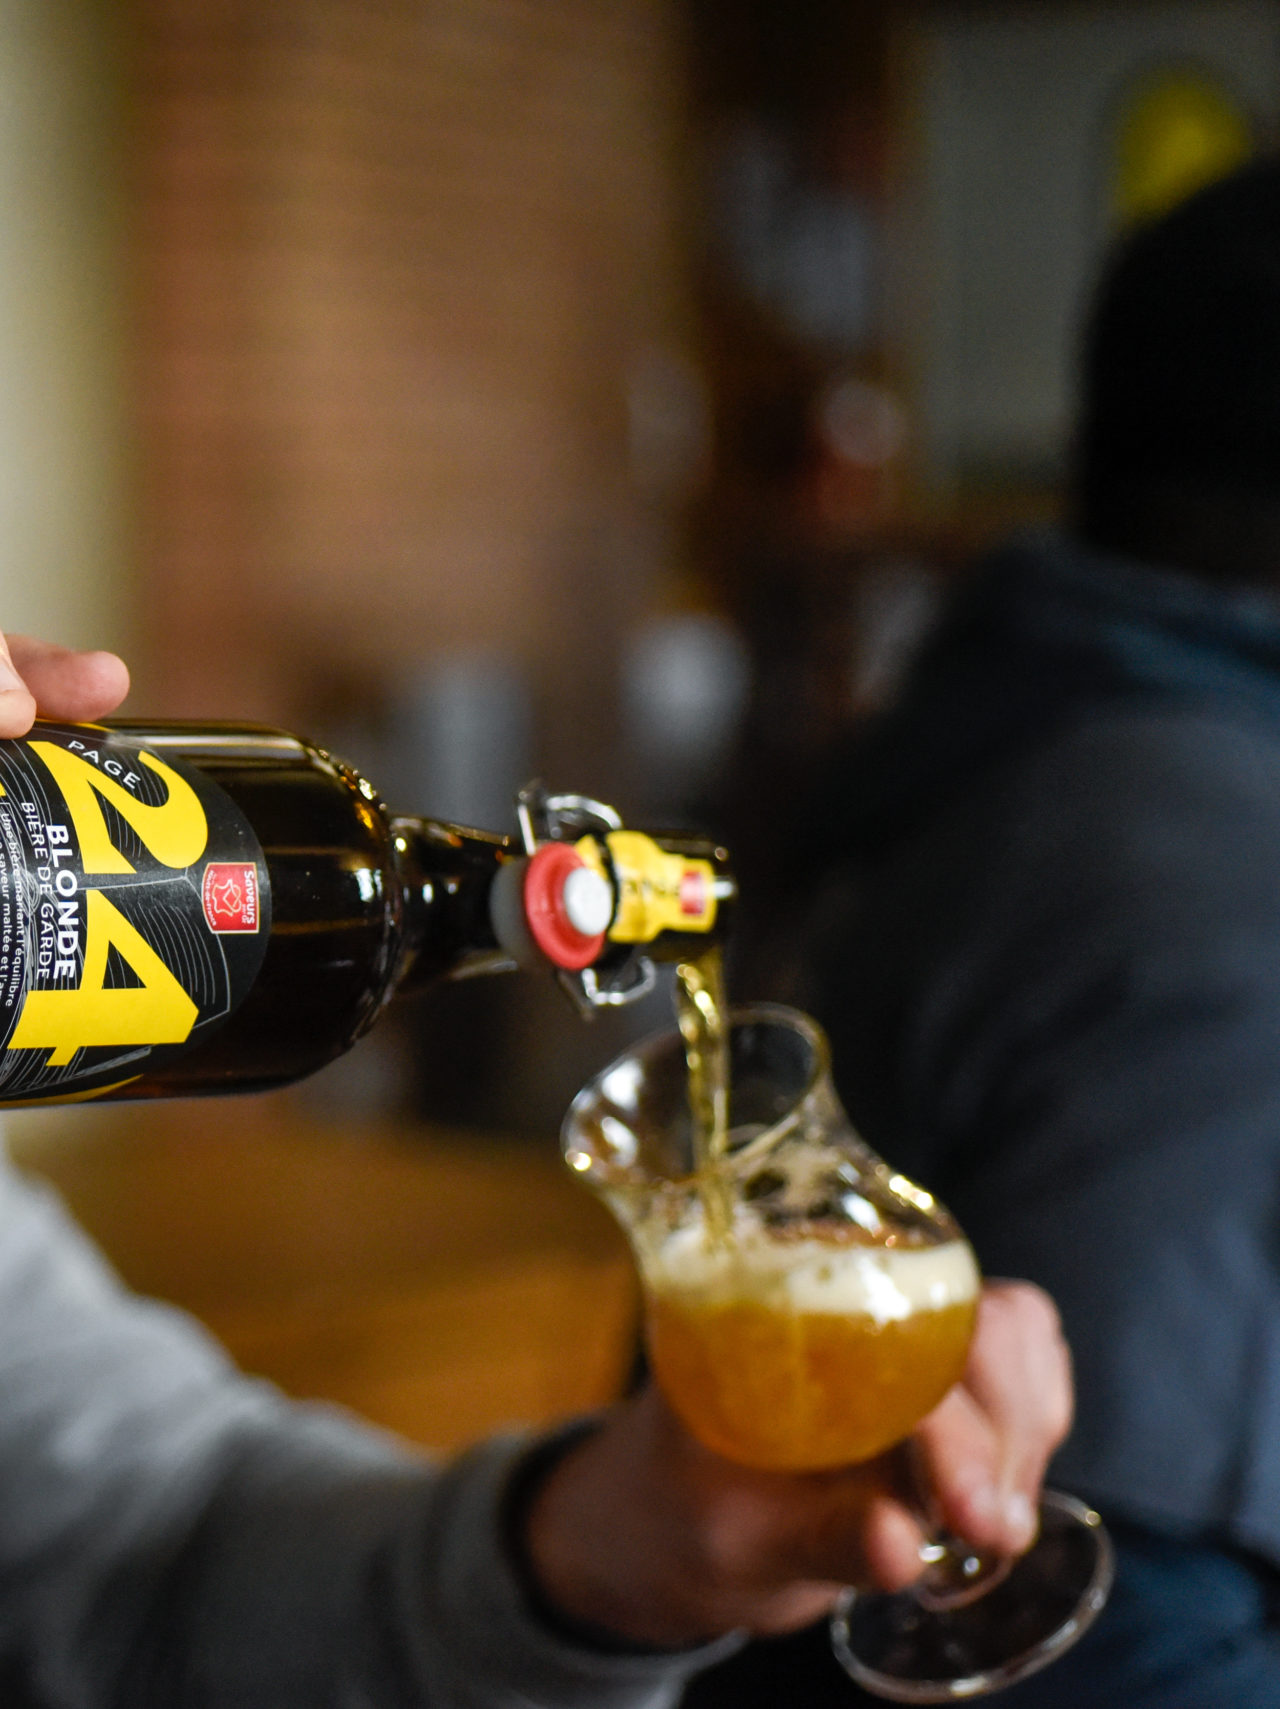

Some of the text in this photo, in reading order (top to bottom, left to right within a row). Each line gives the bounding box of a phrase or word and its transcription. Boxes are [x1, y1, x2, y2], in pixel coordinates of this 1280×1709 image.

[69, 740, 141, 790] PAGE
[0, 813, 13, 839] Une
[8, 842, 22, 876] bière
[7, 741, 208, 1067] 24
[21, 802, 54, 979] BIÈRE DE GARDE
[46, 824, 79, 979] BLONDE
[244, 870, 255, 924] Saveurs
[2, 903, 12, 952] maltée
[0, 956, 9, 969] et
[5, 939, 25, 1007] l'équilibre
